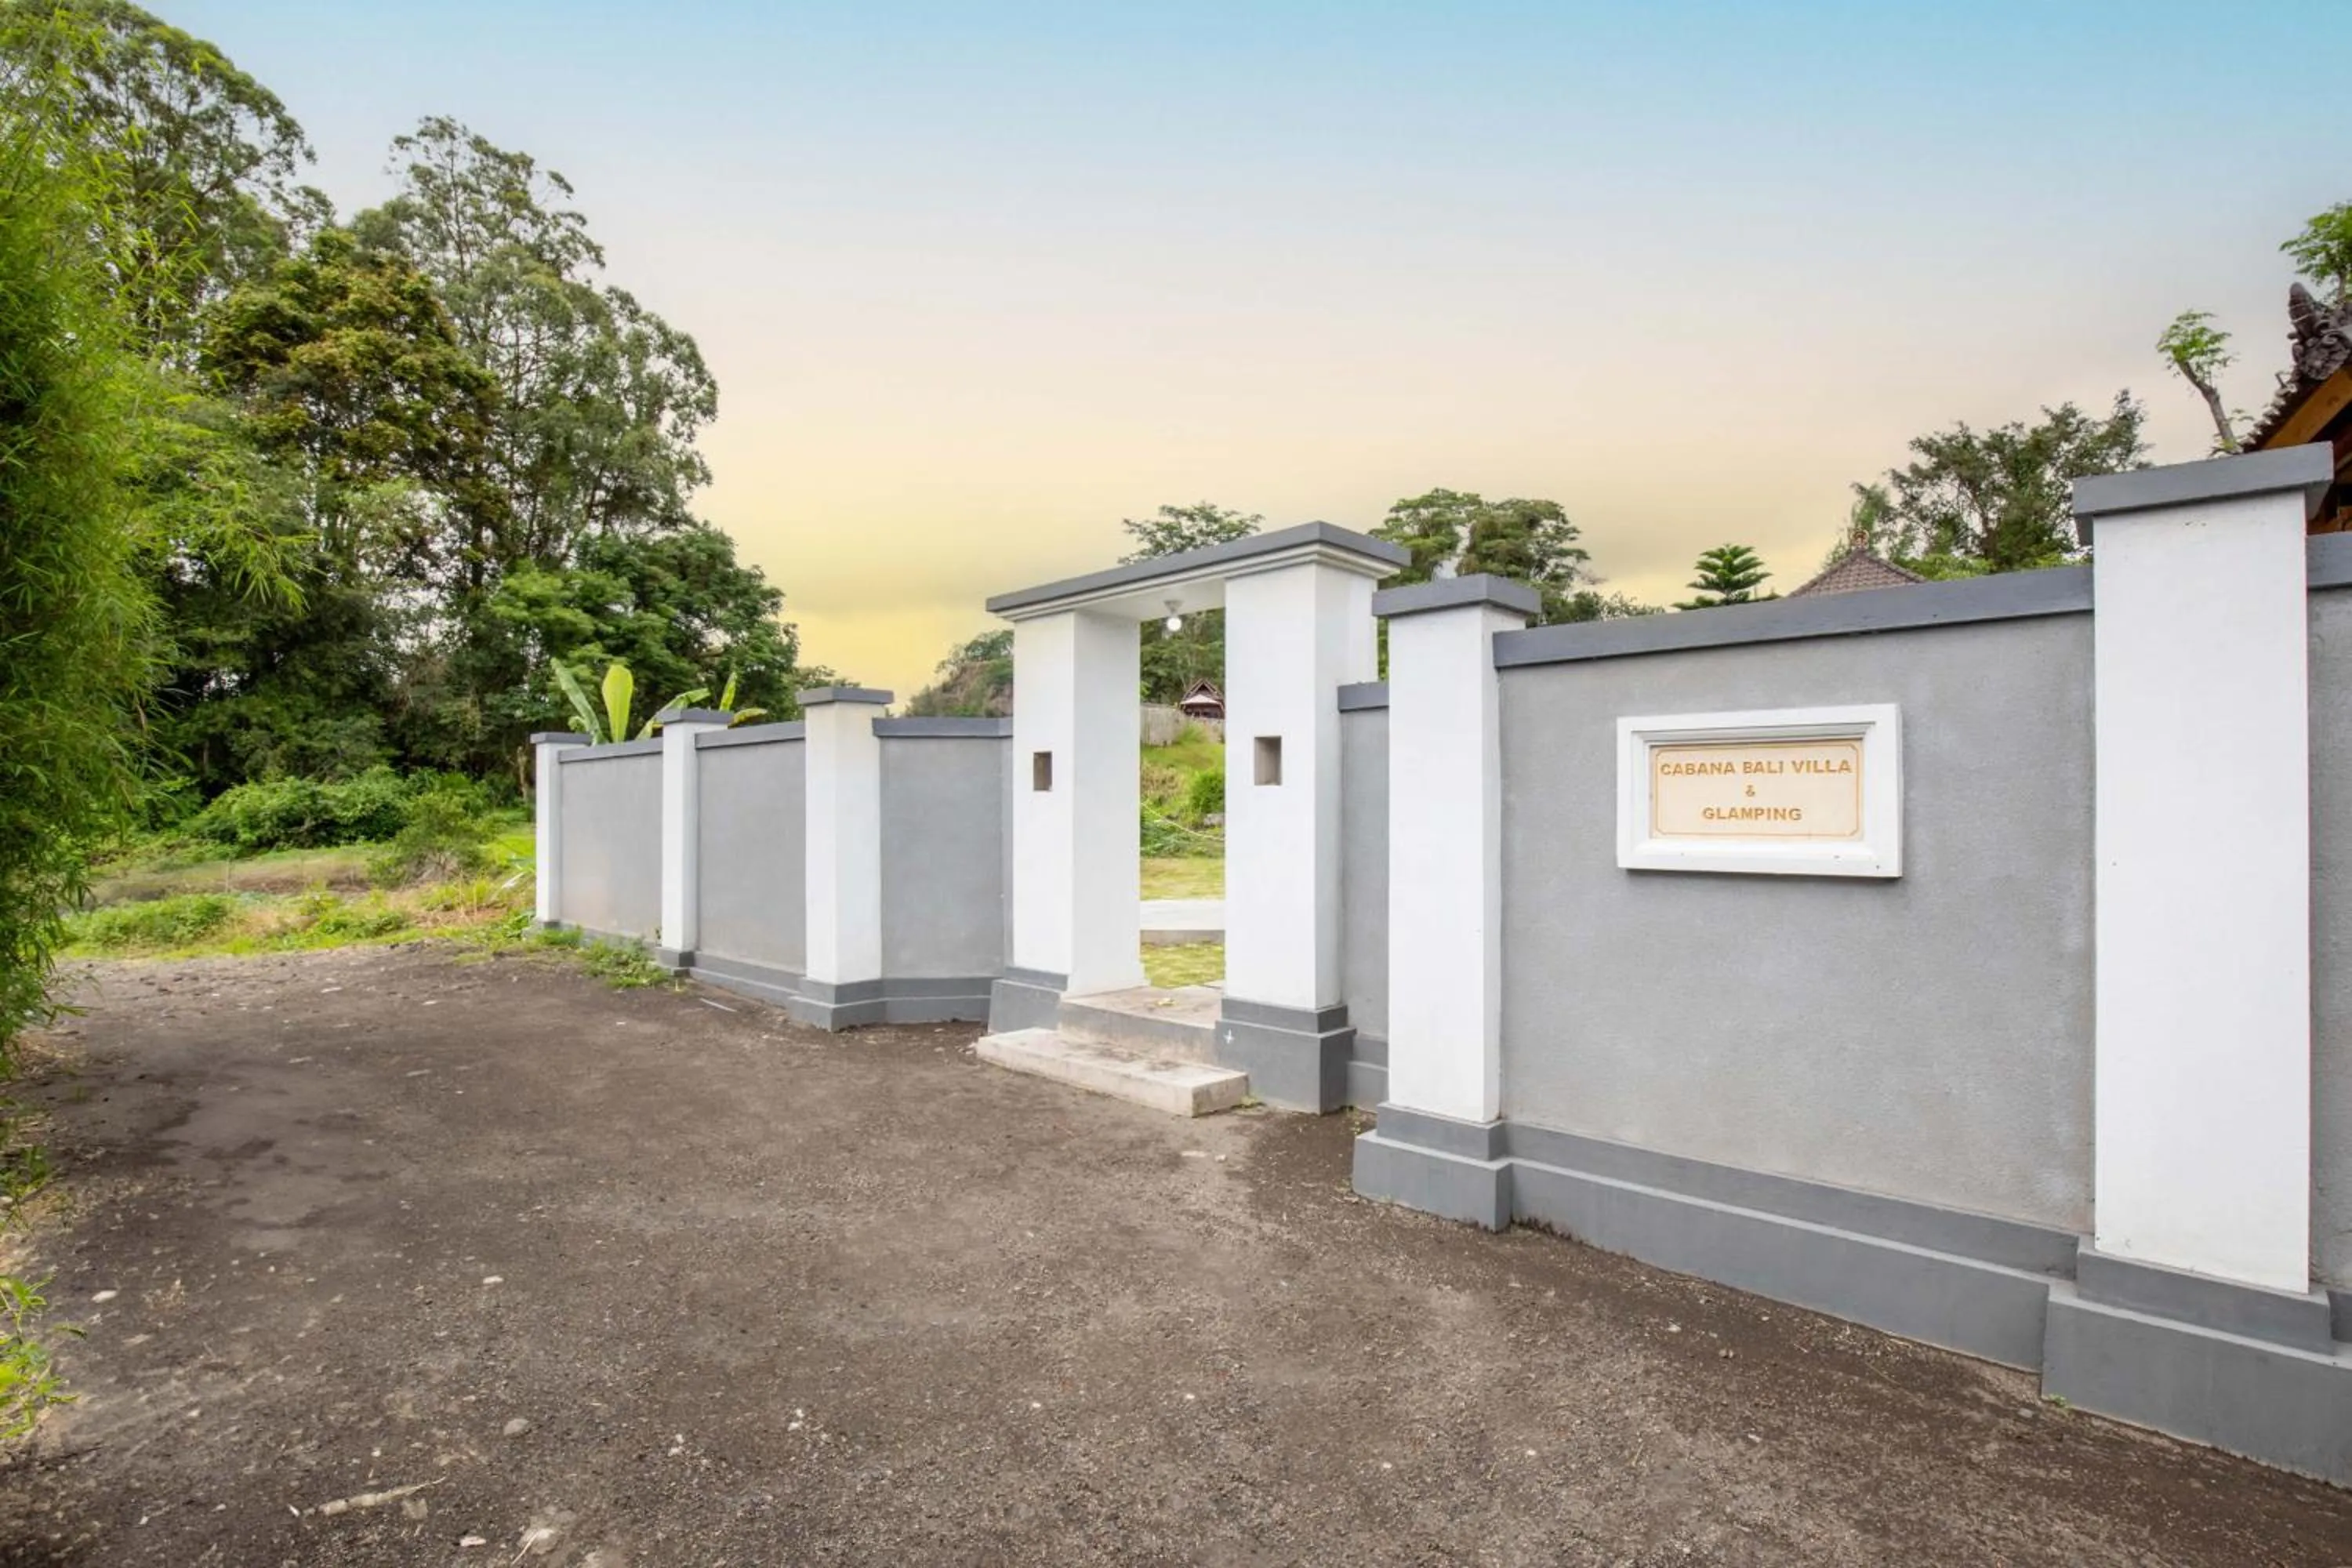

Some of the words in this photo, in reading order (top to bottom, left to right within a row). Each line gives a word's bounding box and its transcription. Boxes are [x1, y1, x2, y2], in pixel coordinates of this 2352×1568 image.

[1660, 761, 1736, 776] CABANA
[1743, 760, 1784, 775] BALI
[1791, 759, 1853, 774] VILLA
[1745, 785, 1756, 797] &
[1702, 807, 1802, 821] GLAMPING
